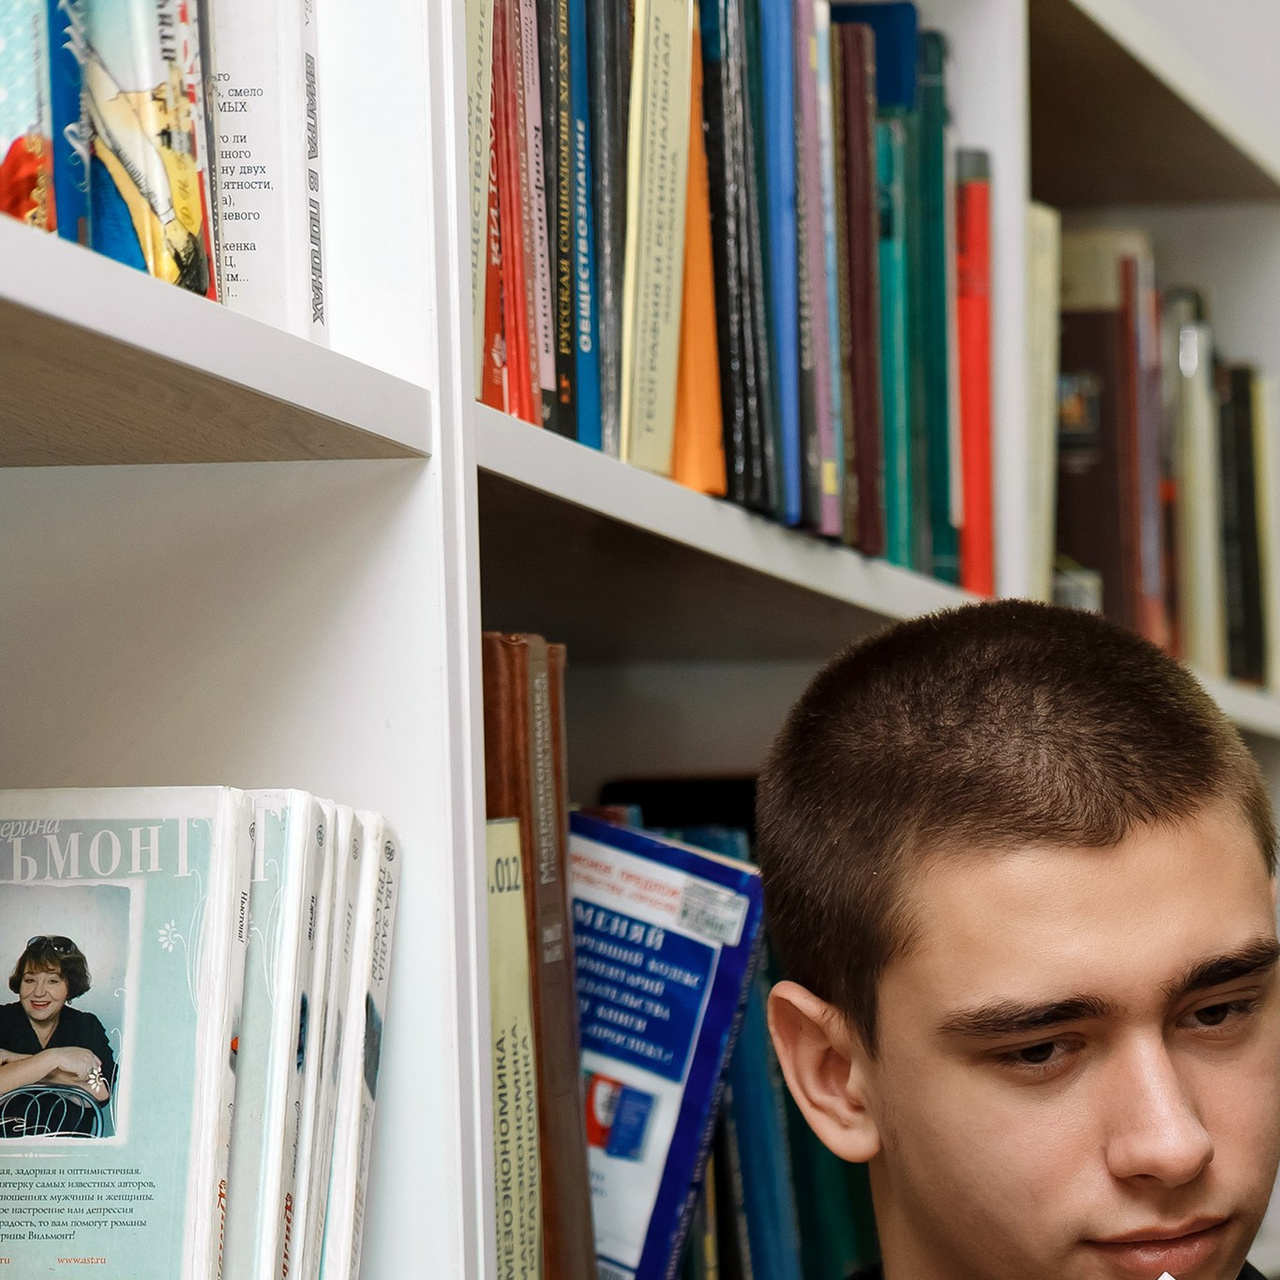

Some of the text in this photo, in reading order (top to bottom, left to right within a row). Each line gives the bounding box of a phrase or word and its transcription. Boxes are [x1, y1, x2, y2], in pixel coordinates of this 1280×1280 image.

[228, 87, 264, 97] смело
[233, 135, 247, 143] ли
[239, 165, 267, 176] двух
[221, 180, 274, 191] ятности,
[308, 168, 319, 193] В
[559, 110, 571, 253] СОЦИОЛОГИЯ
[576, 118, 592, 354] ОБЩЕСТВОЗНАНИЕ
[308, 198, 325, 327] ПОГОНАХ
[559, 260, 572, 355] РУССКАЯ
[521, 1028, 538, 1273] МЕГАЭКОНОМИКА.
[15, 1168, 57, 1178] задорная
[67, 1168, 141, 1176] оптимистичная.
[68, 1180, 115, 1188] известных
[117, 1181, 156, 1190] авторов,
[0, 1193, 48, 1201] ношениях
[50, 1194, 95, 1203] мужчины
[105, 1194, 155, 1203] женщины.
[11, 1206, 66, 1217] настроение
[67, 1206, 84, 1214] или
[86, 1206, 134, 1217] депрессия
[70, 1219, 109, 1229] помогут
[110, 1219, 147, 1229] романы
[28, 1230, 75, 1241] Вильмонт!
[57, 1256, 106, 1265] www.ast.ru
